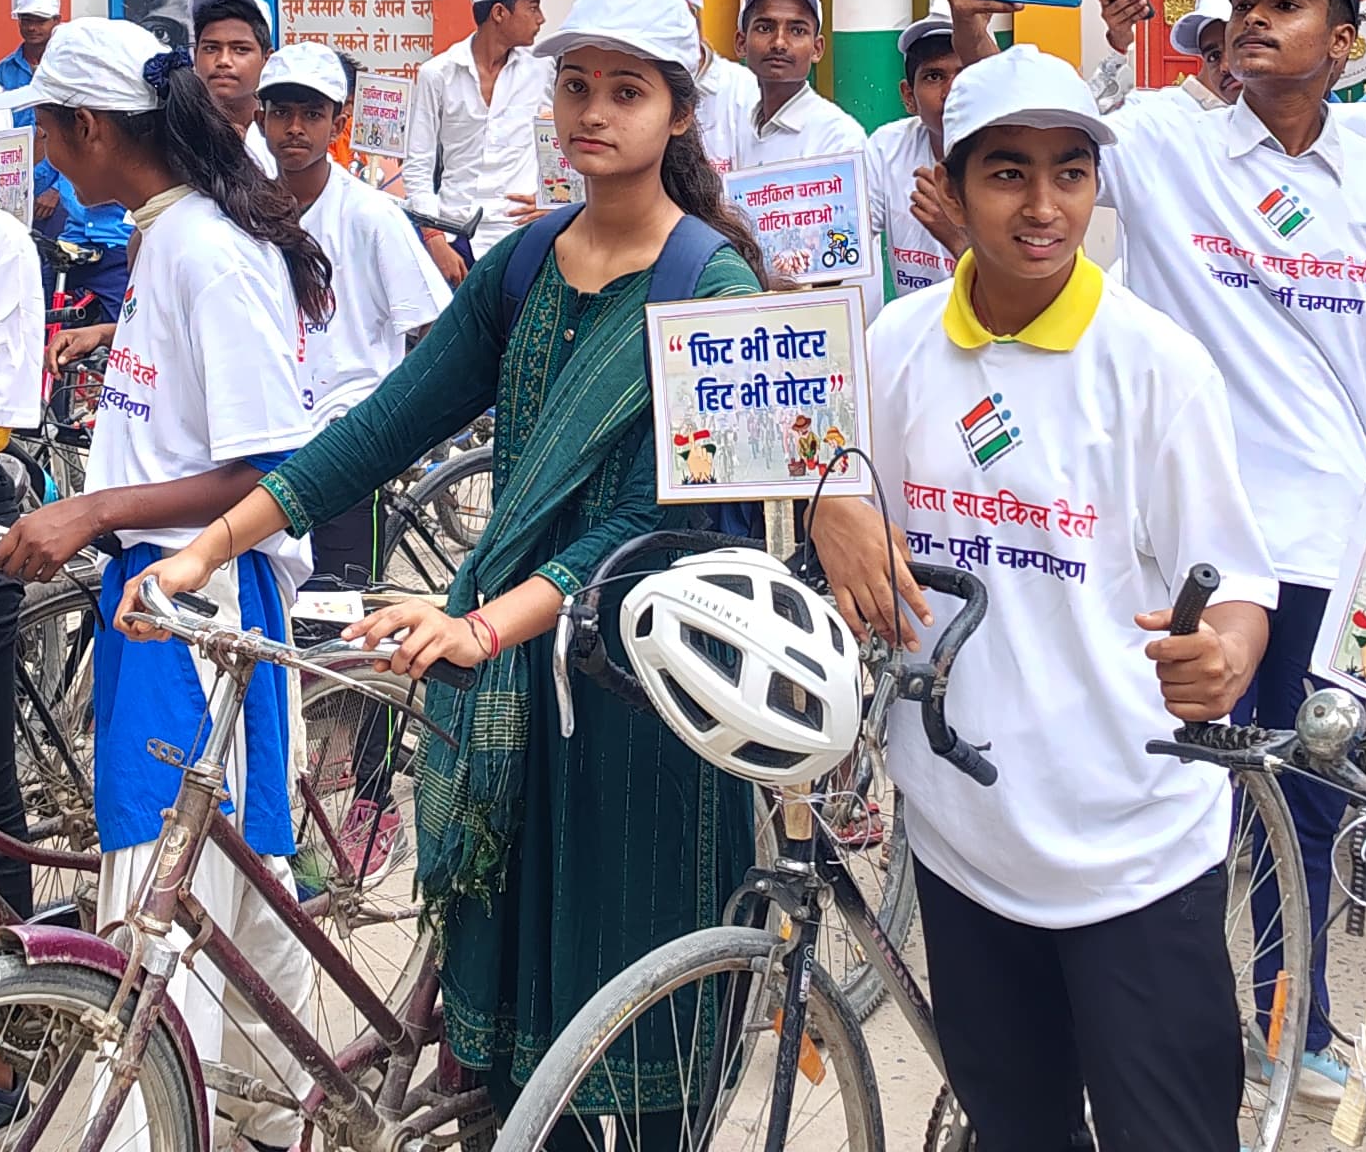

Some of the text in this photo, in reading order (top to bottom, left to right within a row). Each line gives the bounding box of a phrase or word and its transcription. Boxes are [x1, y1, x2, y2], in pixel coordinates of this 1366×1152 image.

[282, 0, 304, 23] तुम
[334, 27, 389, 55] सकते हो
[798, 174, 842, 198] चलाओ
[1262, 252, 1344, 280] साइकिल
[1298, 294, 1365, 315] चम्पारण
[669, 325, 826, 367] “फिट भी वोटर
[695, 374, 844, 412] हिट भी वोटर”
[953, 489, 1098, 539] साइकिल रैली
[948, 535, 1086, 584] पूर्वी चम्पारण
